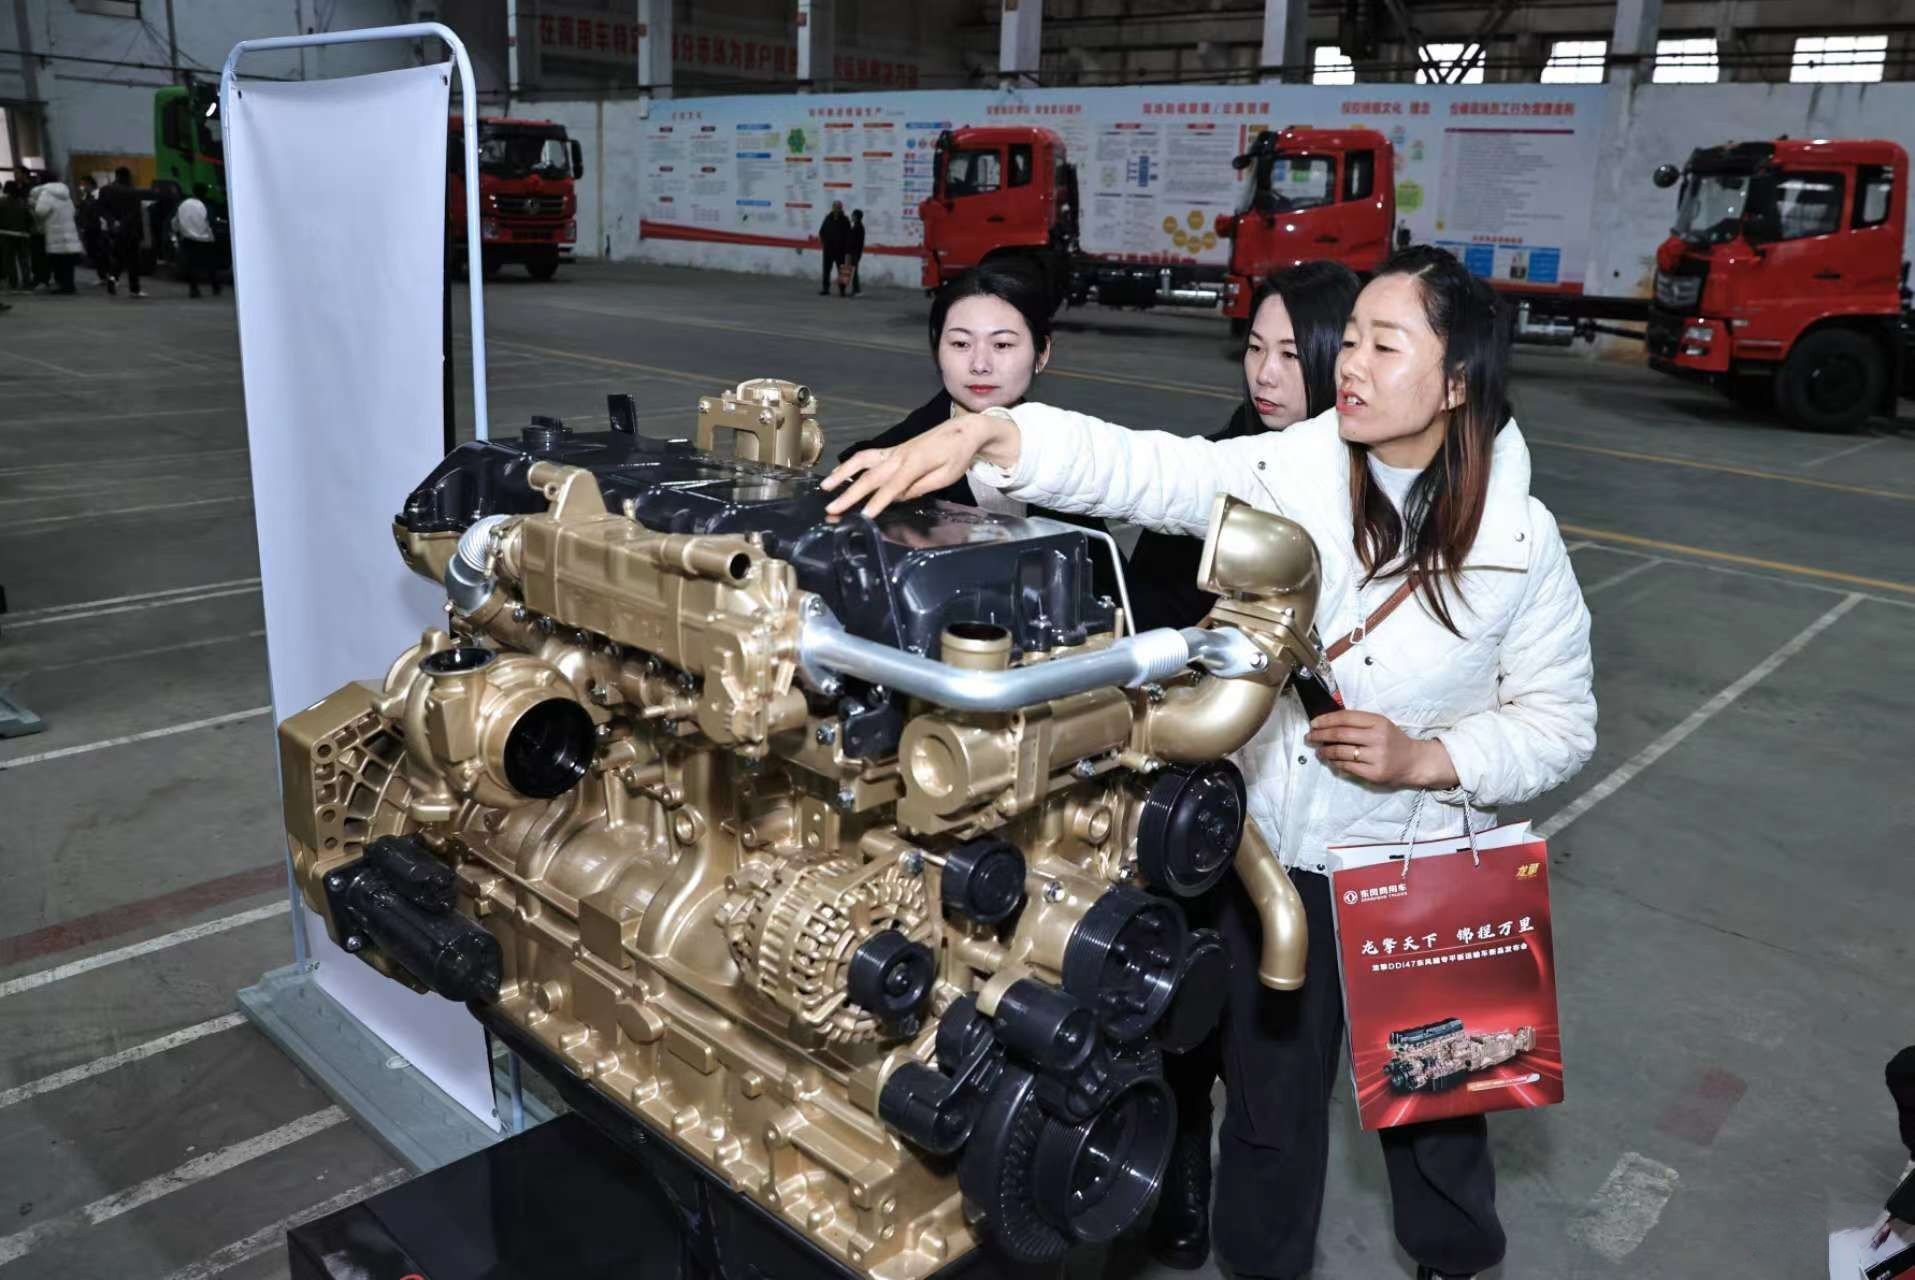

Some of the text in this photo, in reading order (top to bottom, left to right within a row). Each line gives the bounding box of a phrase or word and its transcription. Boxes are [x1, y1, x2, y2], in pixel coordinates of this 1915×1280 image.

[1360, 883, 1407, 898] 东风商用车
[1361, 917, 1535, 956] 龙擎天下 锦程万里
